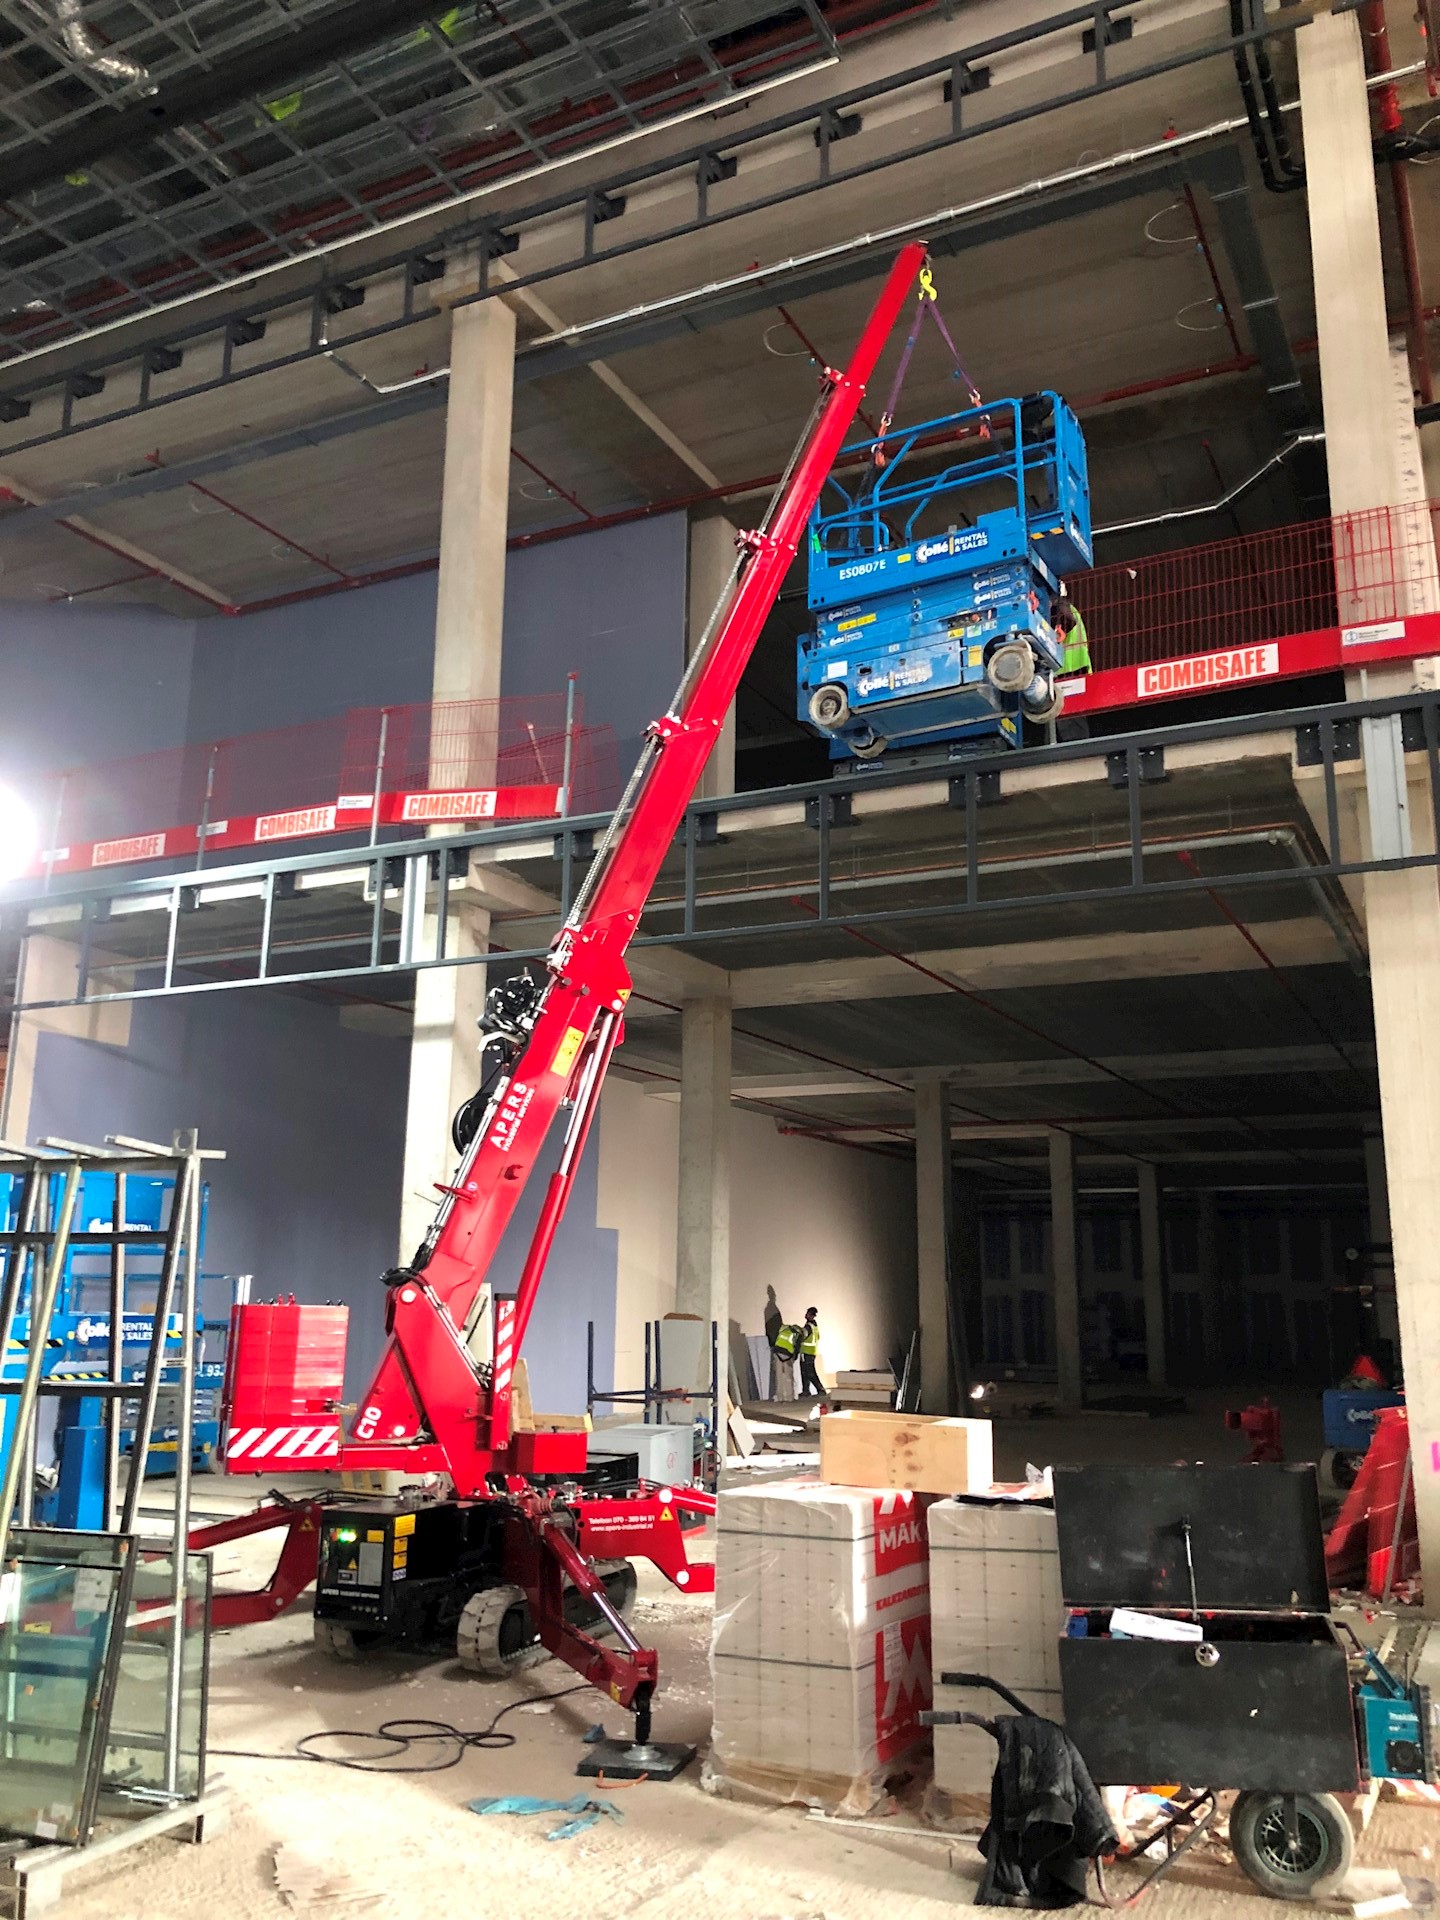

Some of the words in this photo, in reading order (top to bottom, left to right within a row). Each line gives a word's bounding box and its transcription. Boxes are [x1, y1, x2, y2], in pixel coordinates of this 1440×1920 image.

[955, 531, 988, 545] RENTAL
[955, 545, 961, 553] &
[962, 539, 988, 551] SALES
[916, 541, 949, 564] Collé
[839, 559, 887, 580] ES0807E
[1144, 648, 1266, 693] COMBISAFE
[408, 794, 489, 817] COMBISAFE
[260, 809, 329, 838] COMBISAFE
[96, 836, 160, 863] COMBISAFE
[490, 1082, 527, 1149] APERS
[357, 1406, 382, 1439] C10
